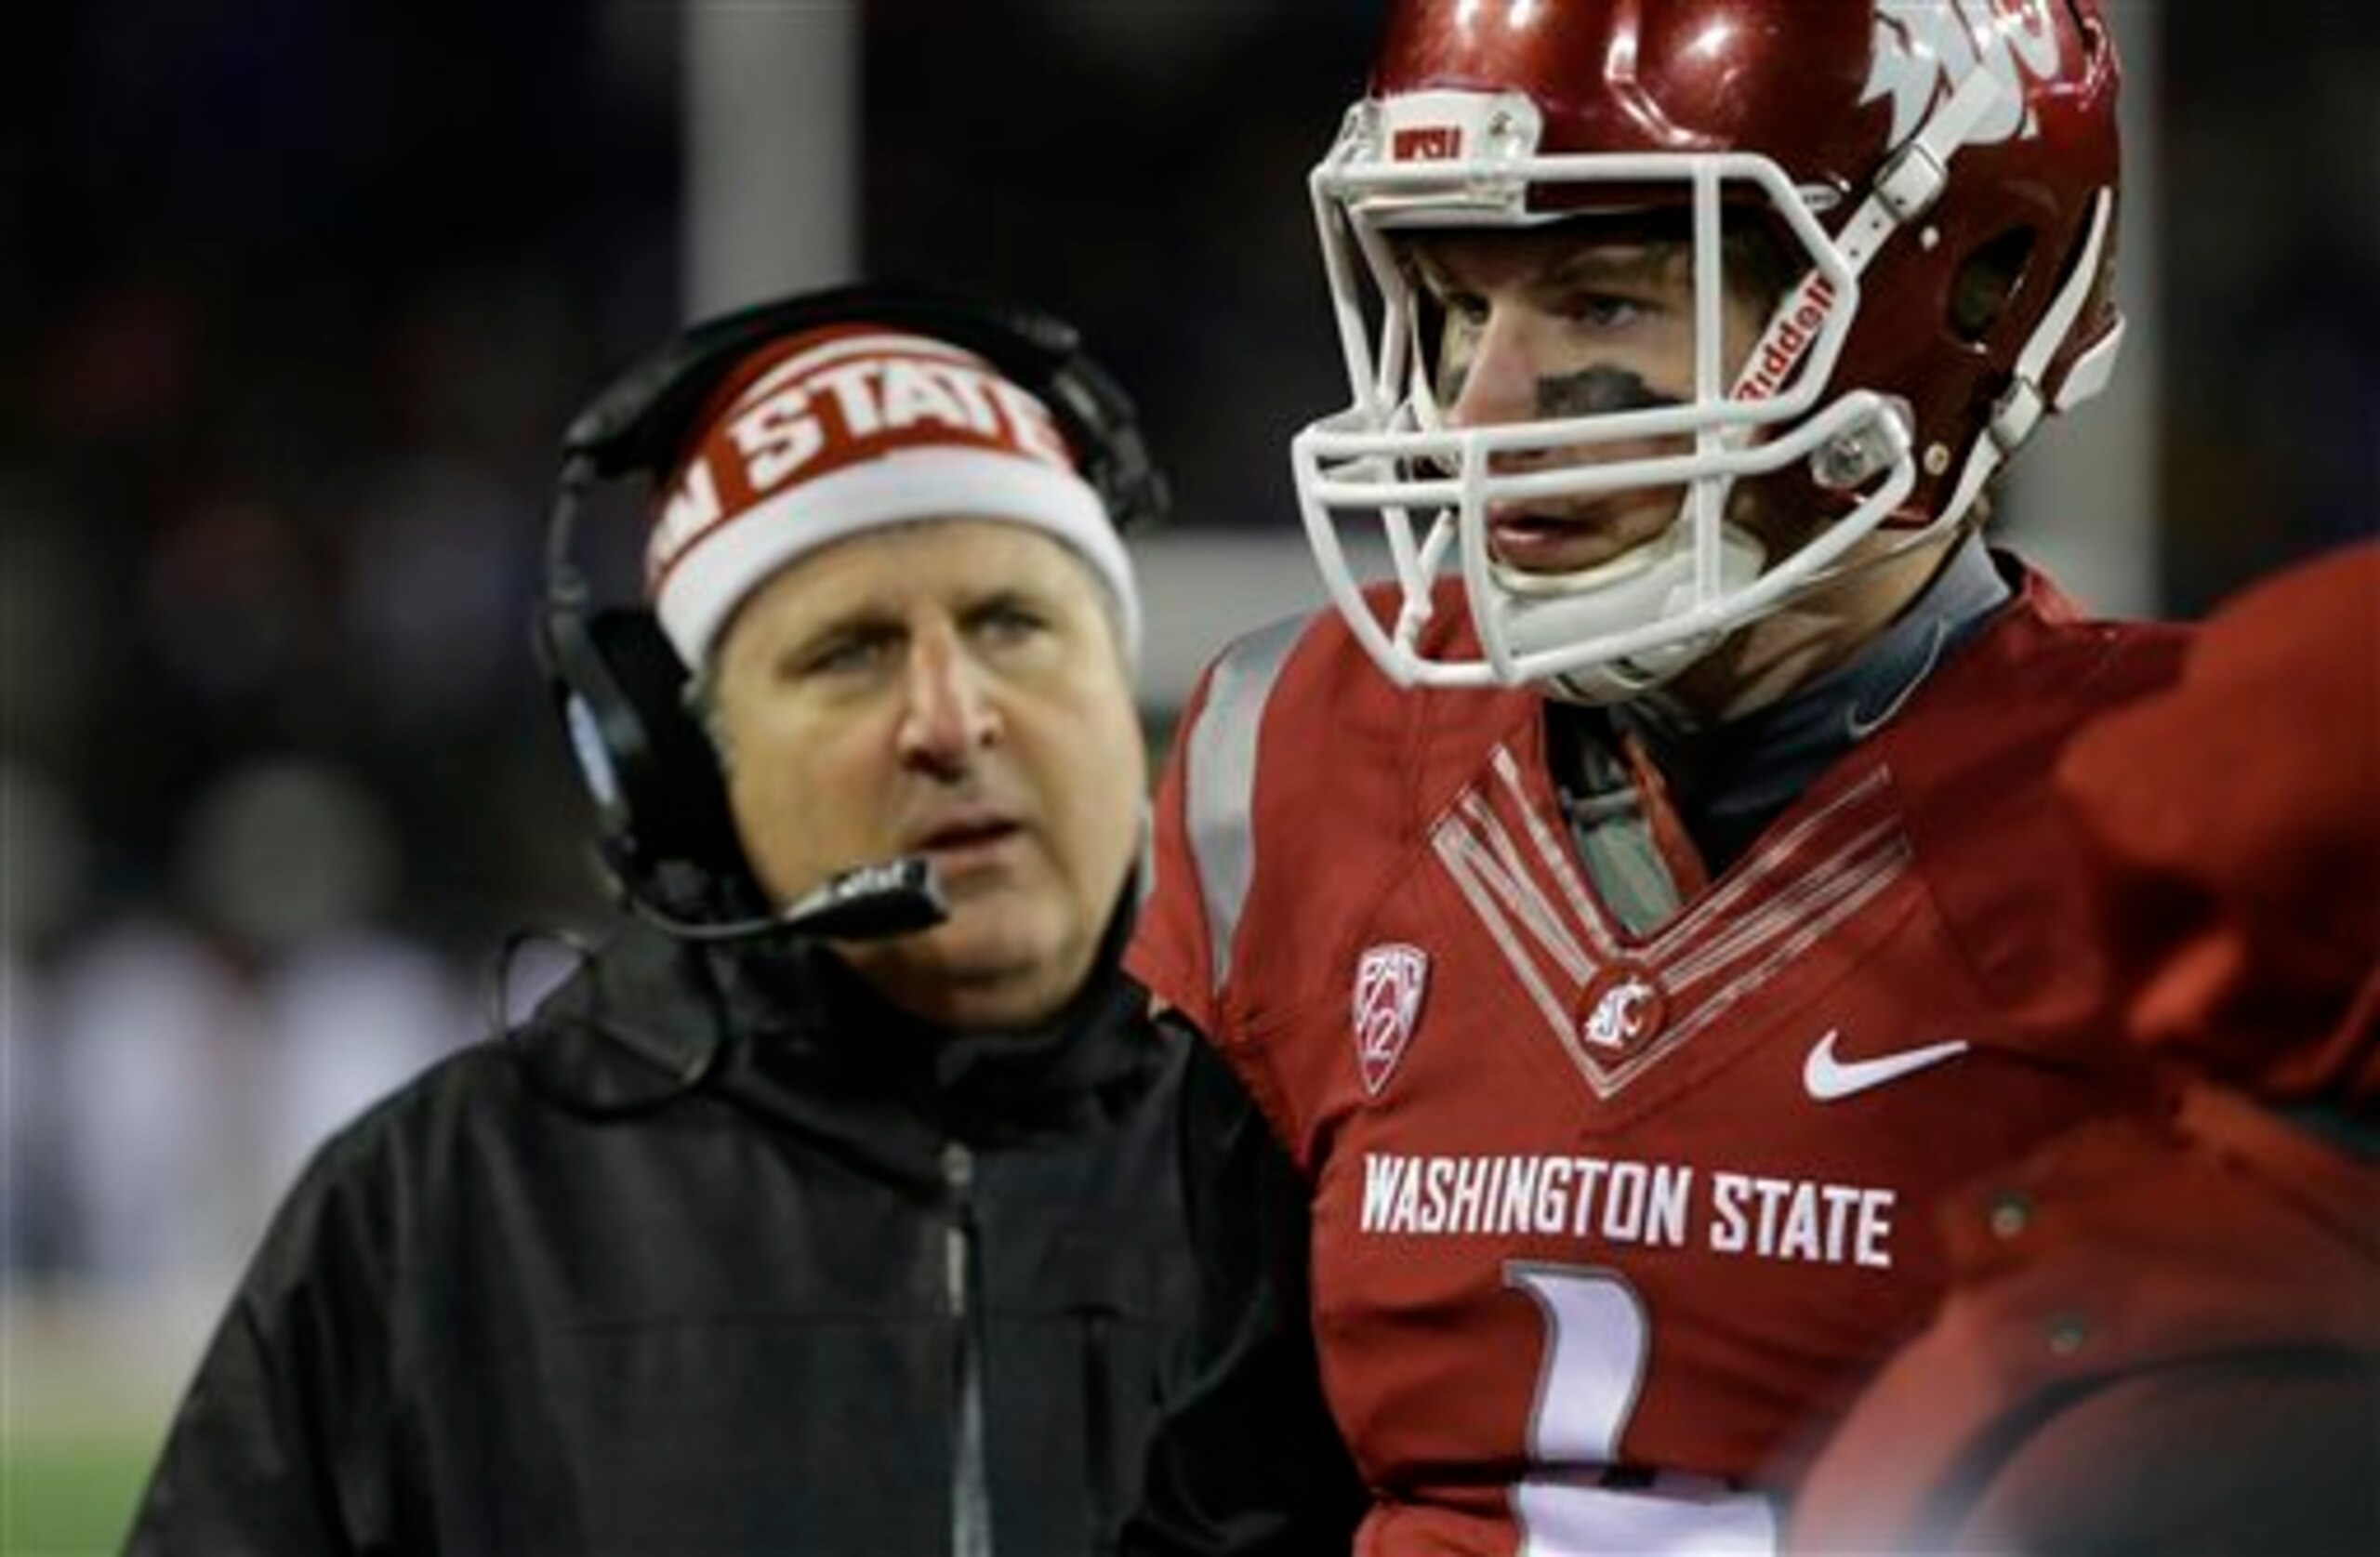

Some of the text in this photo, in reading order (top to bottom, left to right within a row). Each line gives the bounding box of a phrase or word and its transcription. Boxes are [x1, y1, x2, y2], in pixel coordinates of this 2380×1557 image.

[1361, 1153, 1896, 1268] WASHINGTON STATE
[1502, 1259, 1778, 1557] 1
